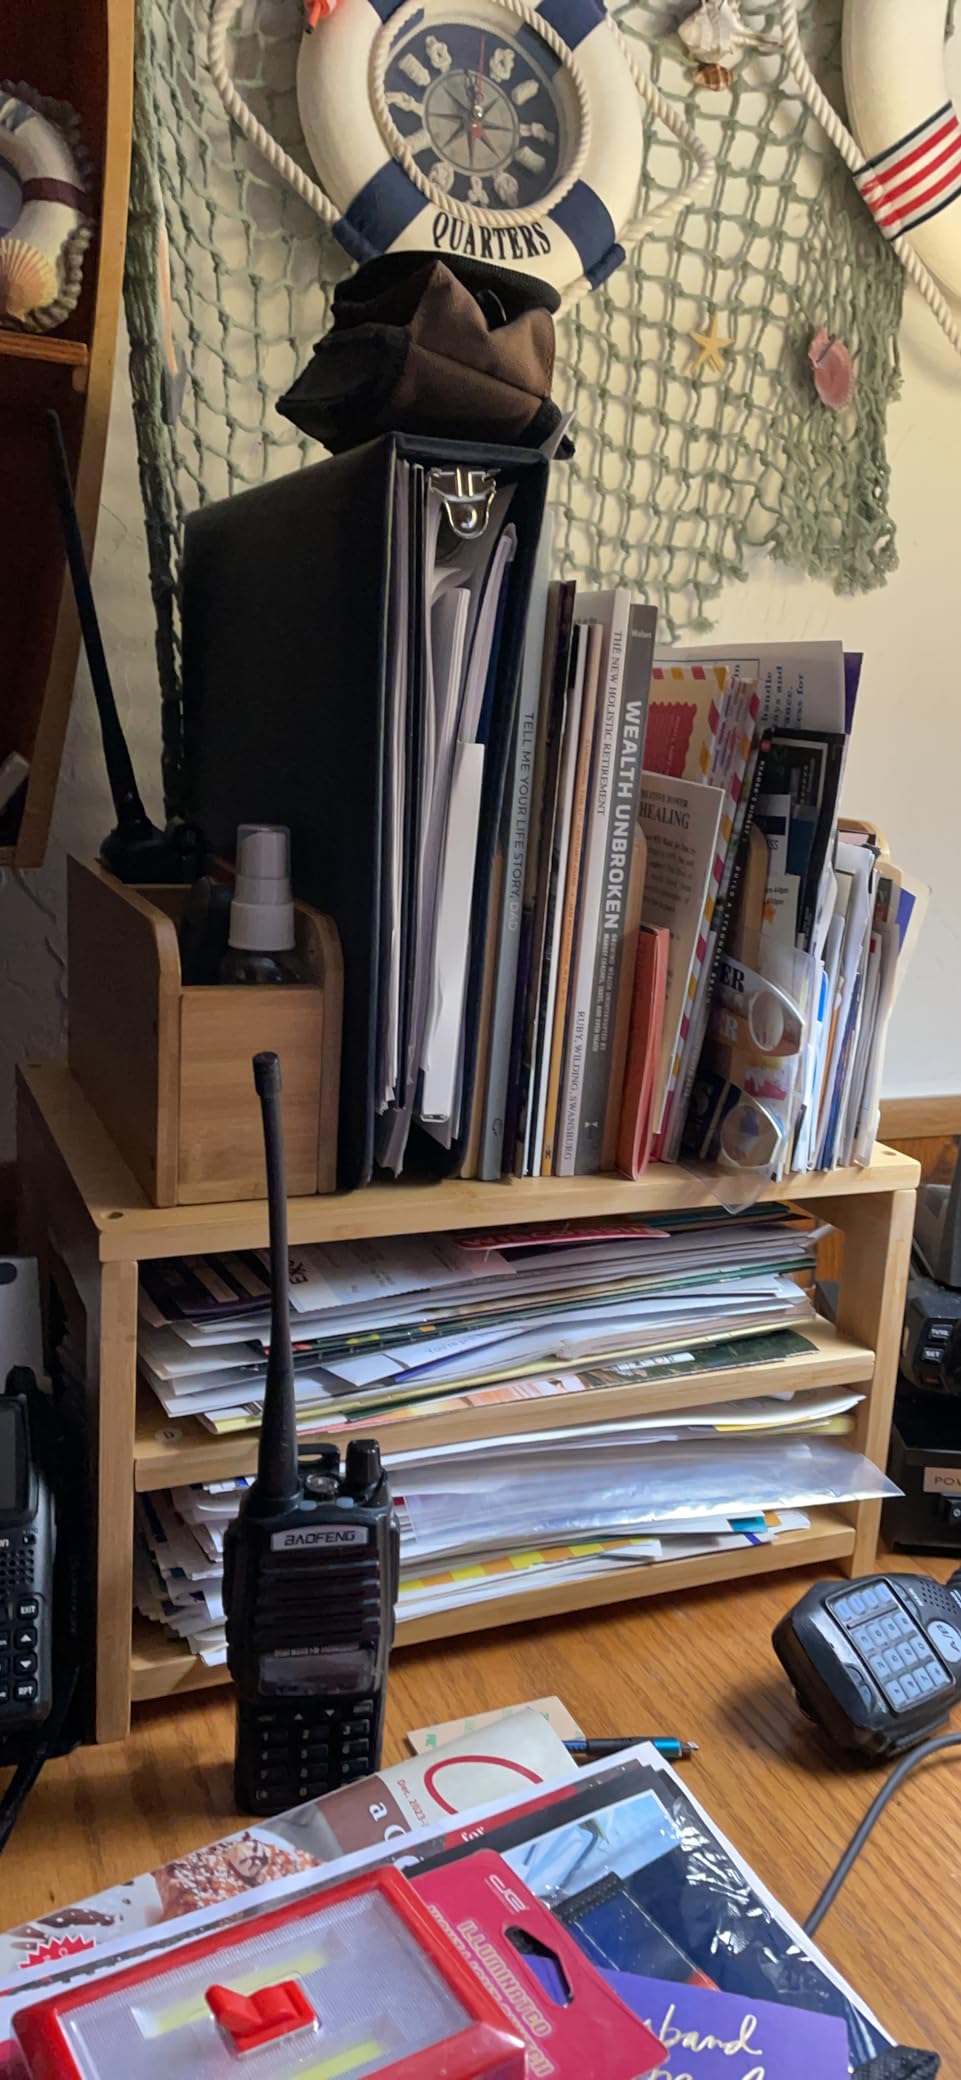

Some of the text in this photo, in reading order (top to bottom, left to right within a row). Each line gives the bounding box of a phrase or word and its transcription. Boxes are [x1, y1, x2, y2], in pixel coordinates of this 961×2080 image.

[432, 212, 552, 260] QUARTERS
[597, 631, 624, 815] THE NEW HOLISTIC RETIREMENT
[509, 712, 534, 931] TELL ME YOUR LIFE STORY, DAD
[604, 701, 643, 929] WEALTH UNBROKEN
[640, 801, 690, 829] HEALING
[564, 1011, 585, 1160] RUBY, WILDING, SWANSBURG
[284, 1530, 356, 1546] BAOFENG
[20, 1605, 36, 1614] EXIT
[18, 1686, 33, 1695] RPT
[457, 1920, 553, 2038] ILLUMINATED
